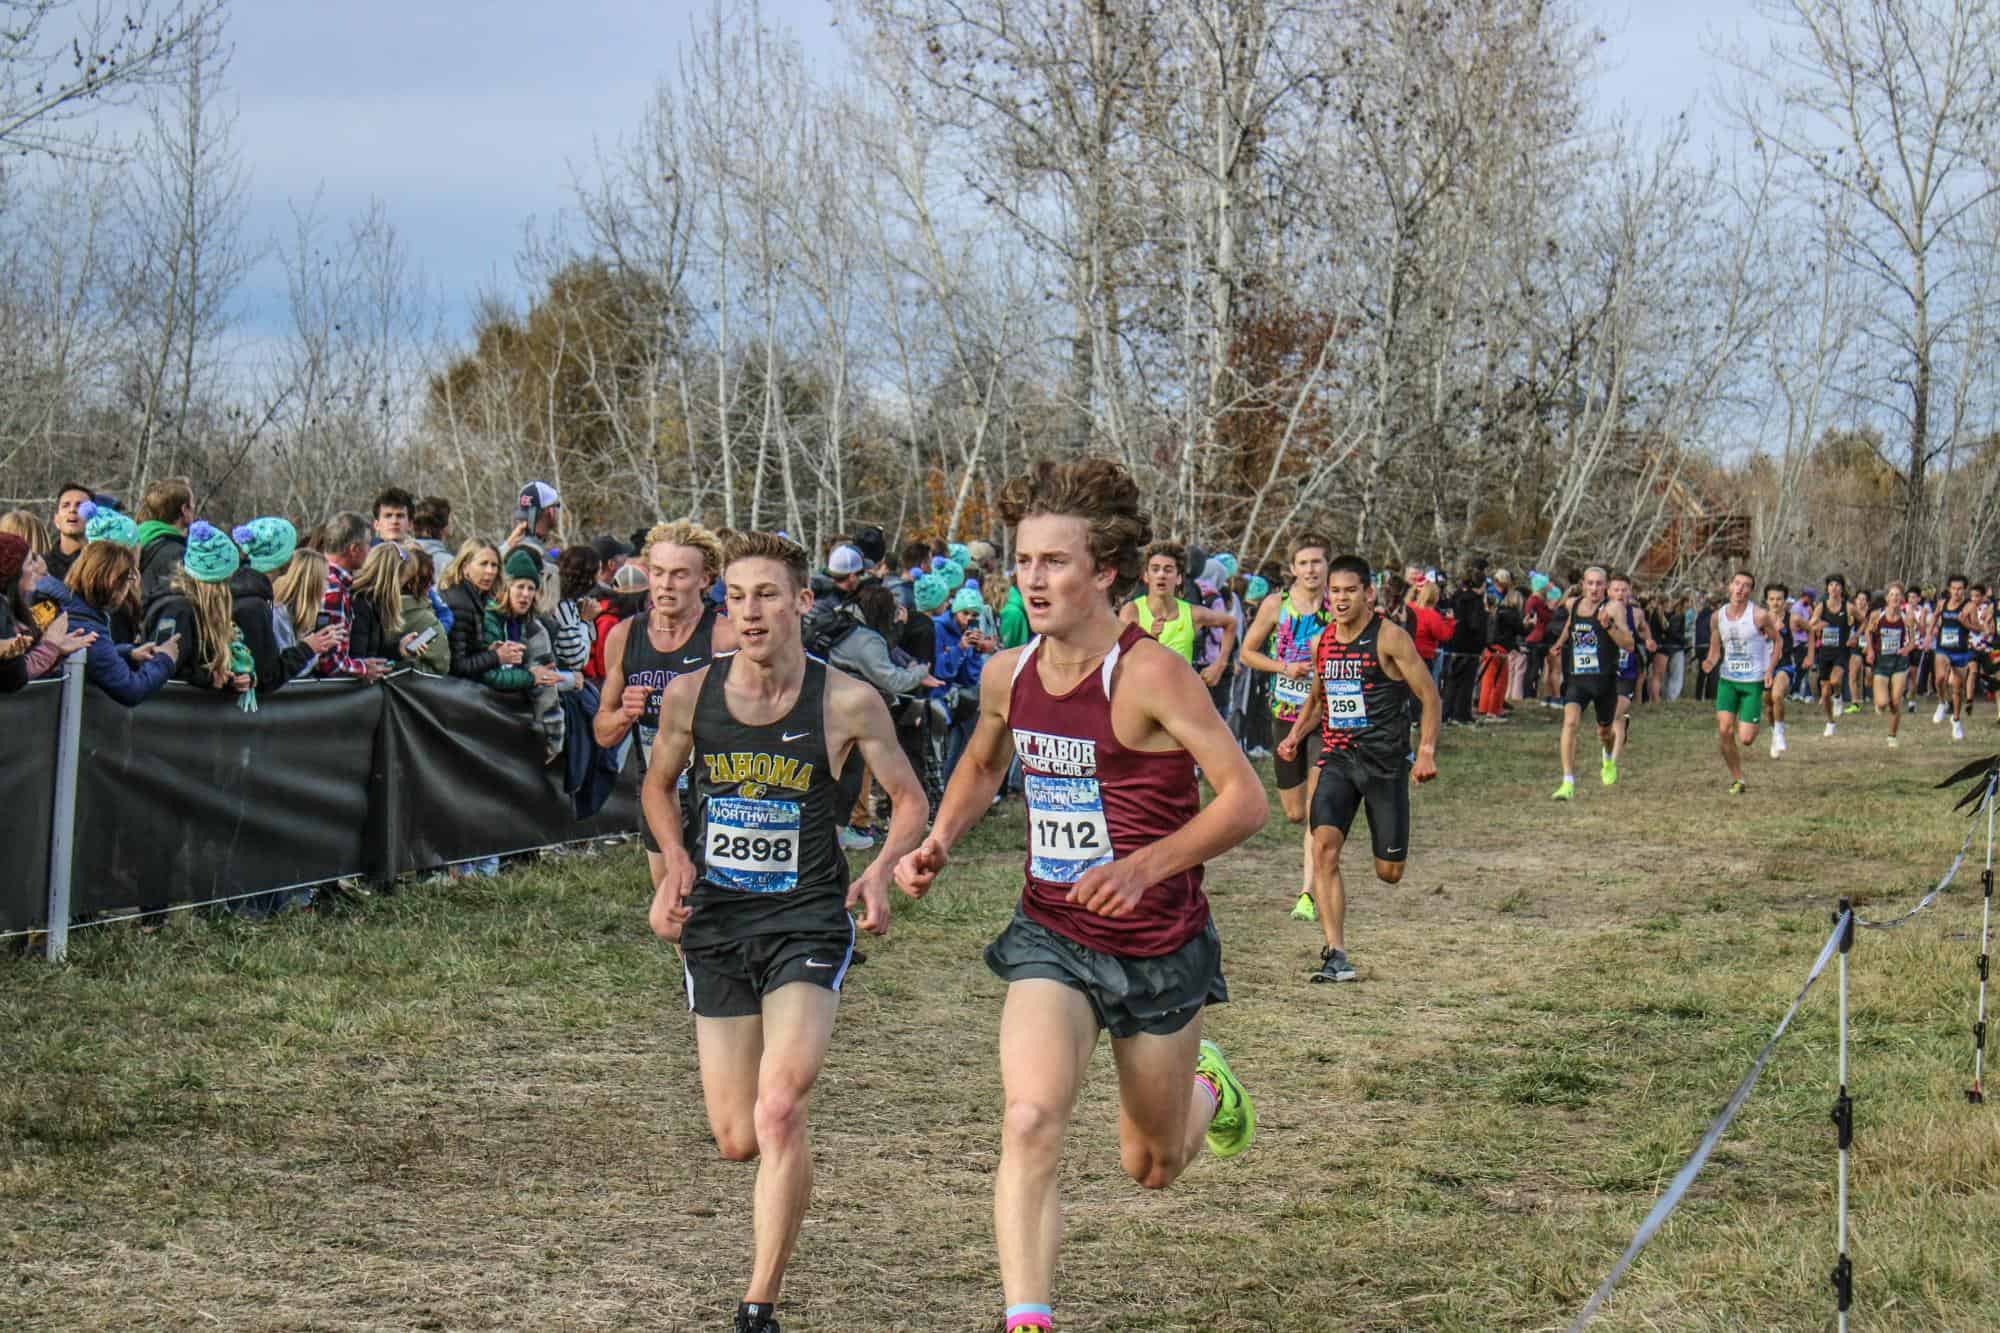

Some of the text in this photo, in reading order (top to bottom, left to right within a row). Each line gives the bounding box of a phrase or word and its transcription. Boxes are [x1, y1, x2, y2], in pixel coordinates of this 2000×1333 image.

[1325, 660, 1361, 679] BOISE
[1332, 700, 1356, 713] 259
[1035, 735, 1096, 765] TABOR
[703, 752, 814, 792] TAHOMA
[1052, 761, 1082, 777] CLUB
[1031, 789, 1097, 806] NORTHWE
[711, 806, 796, 824] NORTHWE
[1038, 820, 1099, 849] 1712
[712, 833, 793, 862] 2898
